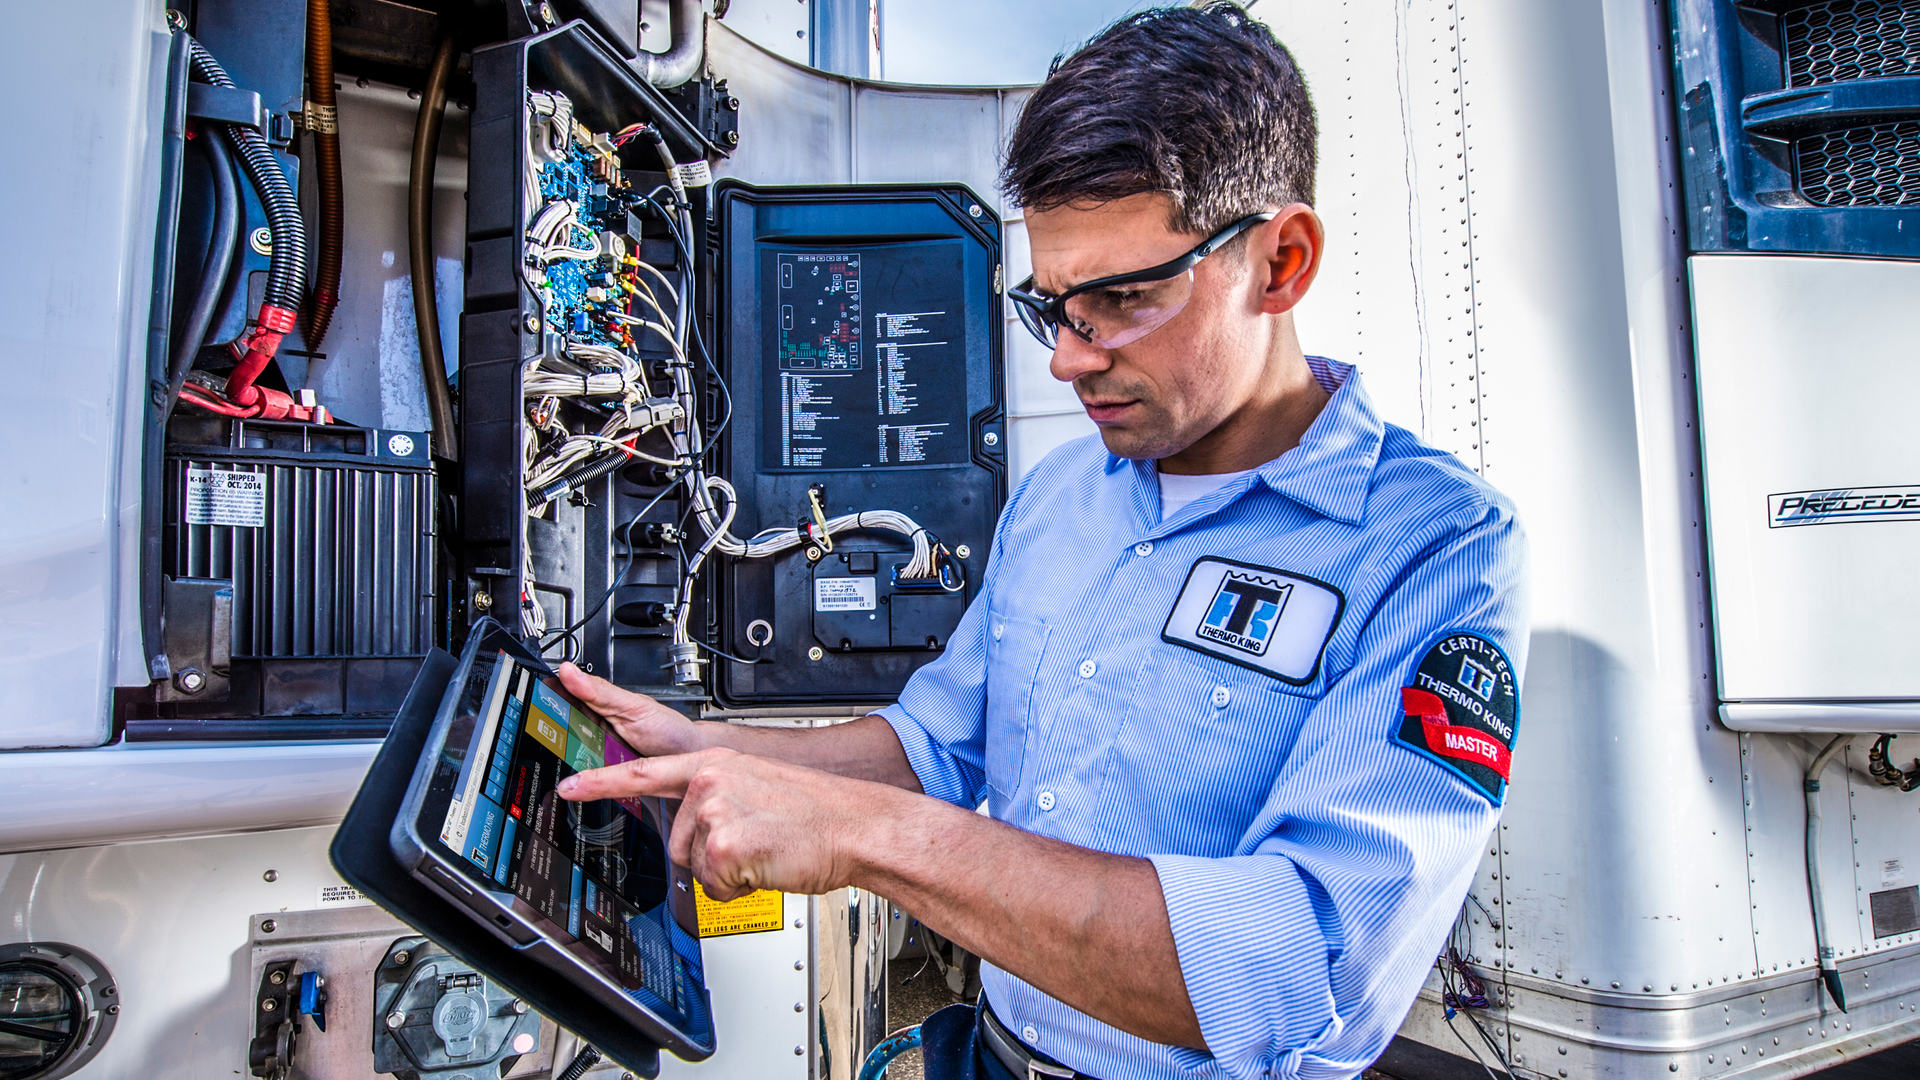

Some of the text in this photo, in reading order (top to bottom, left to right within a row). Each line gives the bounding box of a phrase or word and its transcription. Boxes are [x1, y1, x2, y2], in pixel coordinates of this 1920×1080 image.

[228, 473, 255, 482] SHIPPED
[1778, 494, 1920, 516] PRECEDE
[1202, 626, 1261, 651] THERMO KING
[1439, 636, 1514, 697] CERTI-TECH
[1418, 672, 1513, 740] THERMO KING
[1444, 732, 1498, 762] MASTER
[478, 810, 494, 852] THERMO KING
[534, 803, 545, 834] DEVELOPMENT
[497, 861, 506, 882] PROFILE
[570, 908, 579, 935] EQUIPMENT
